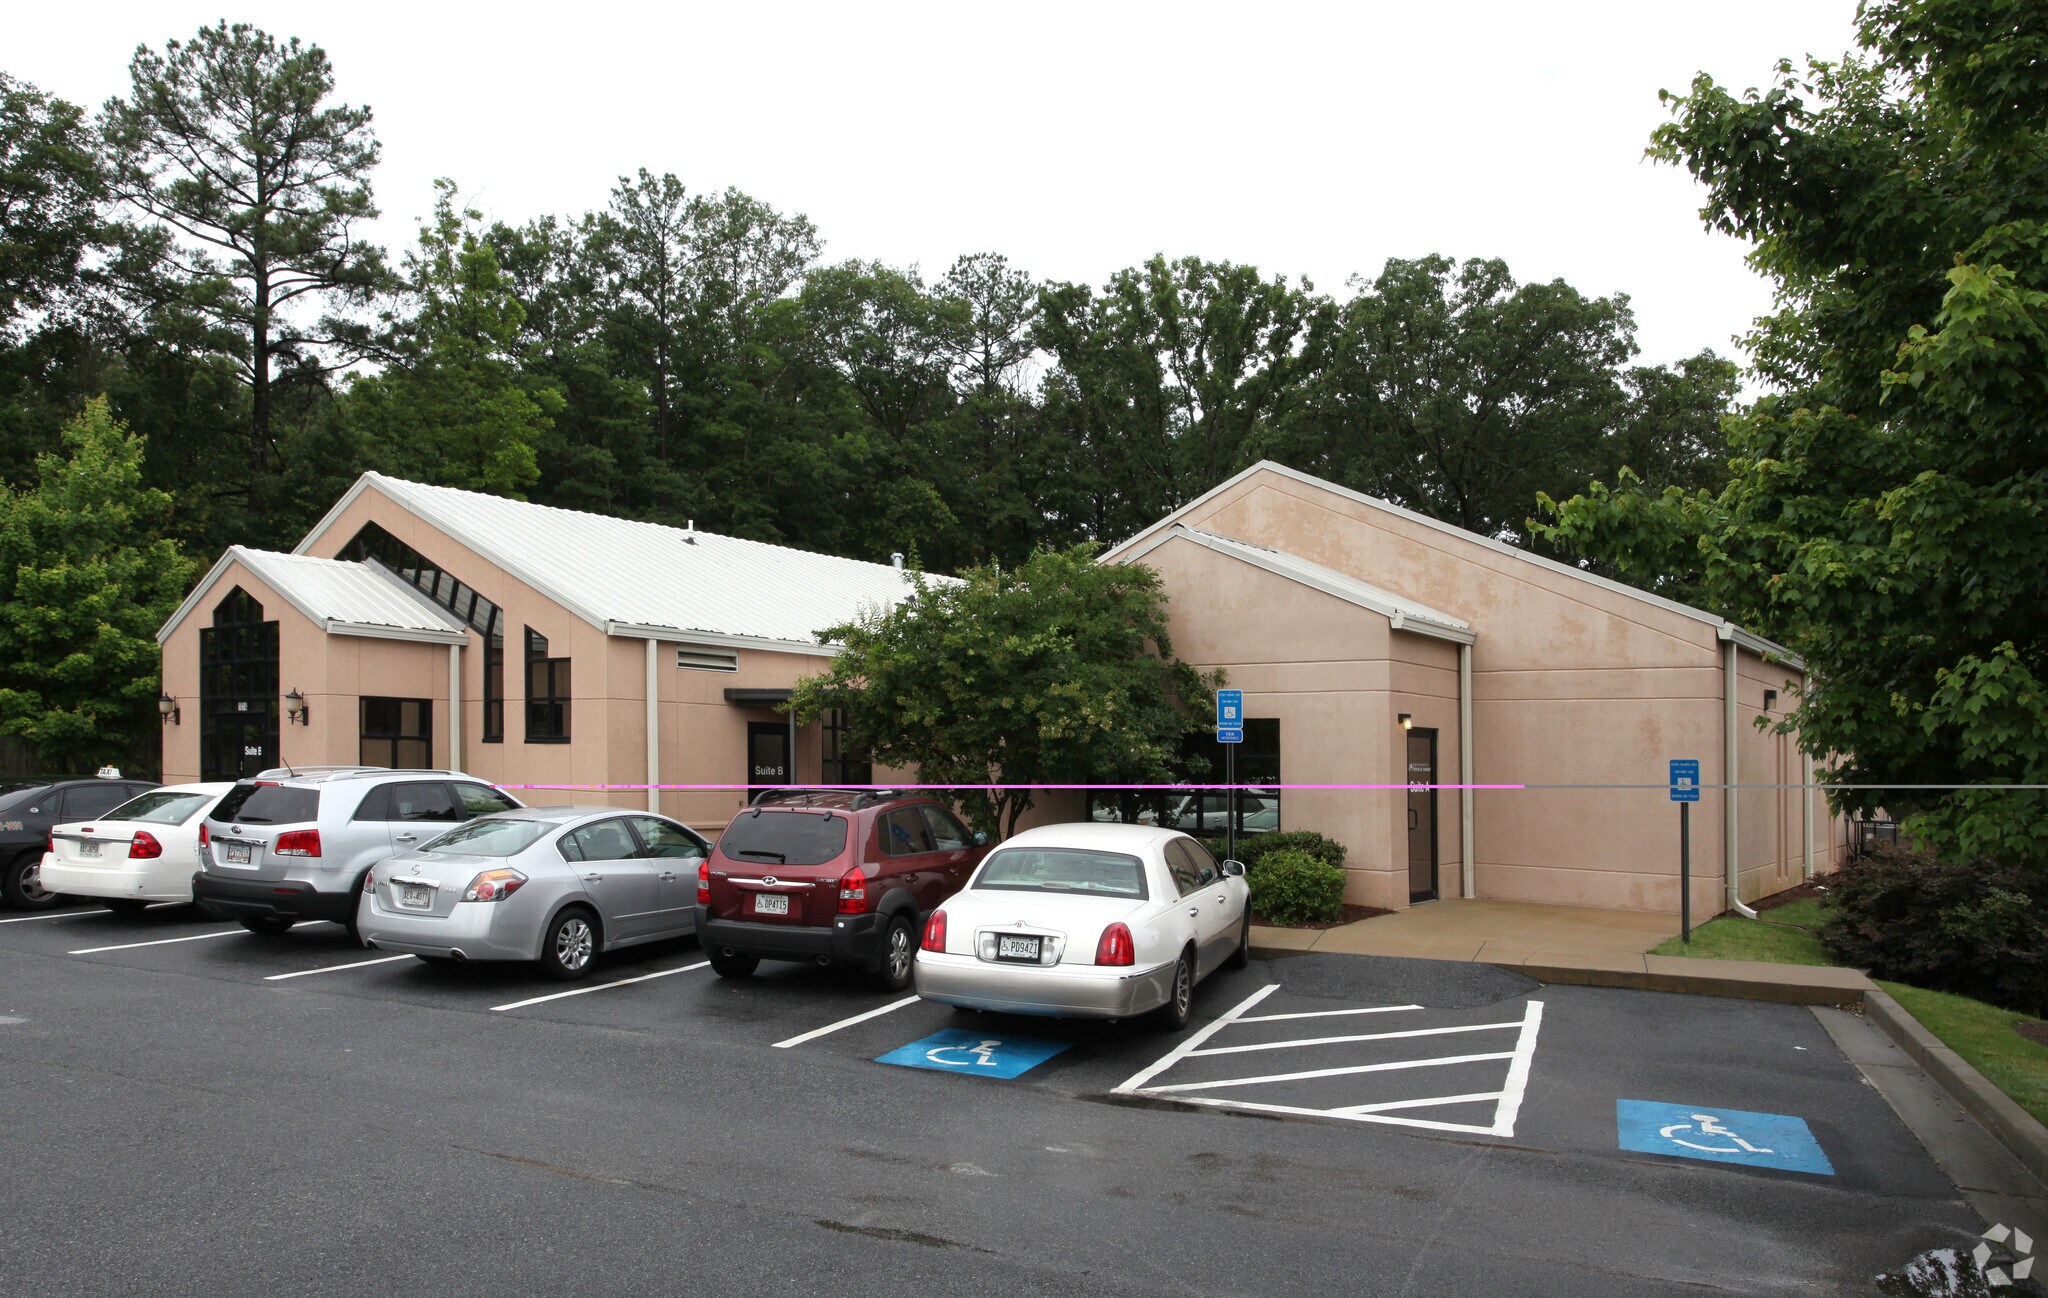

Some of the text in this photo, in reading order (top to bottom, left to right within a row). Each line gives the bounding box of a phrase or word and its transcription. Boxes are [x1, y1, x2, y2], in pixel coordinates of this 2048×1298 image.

[245, 746, 257, 755] Suite
[755, 765, 783, 775] Suite B
